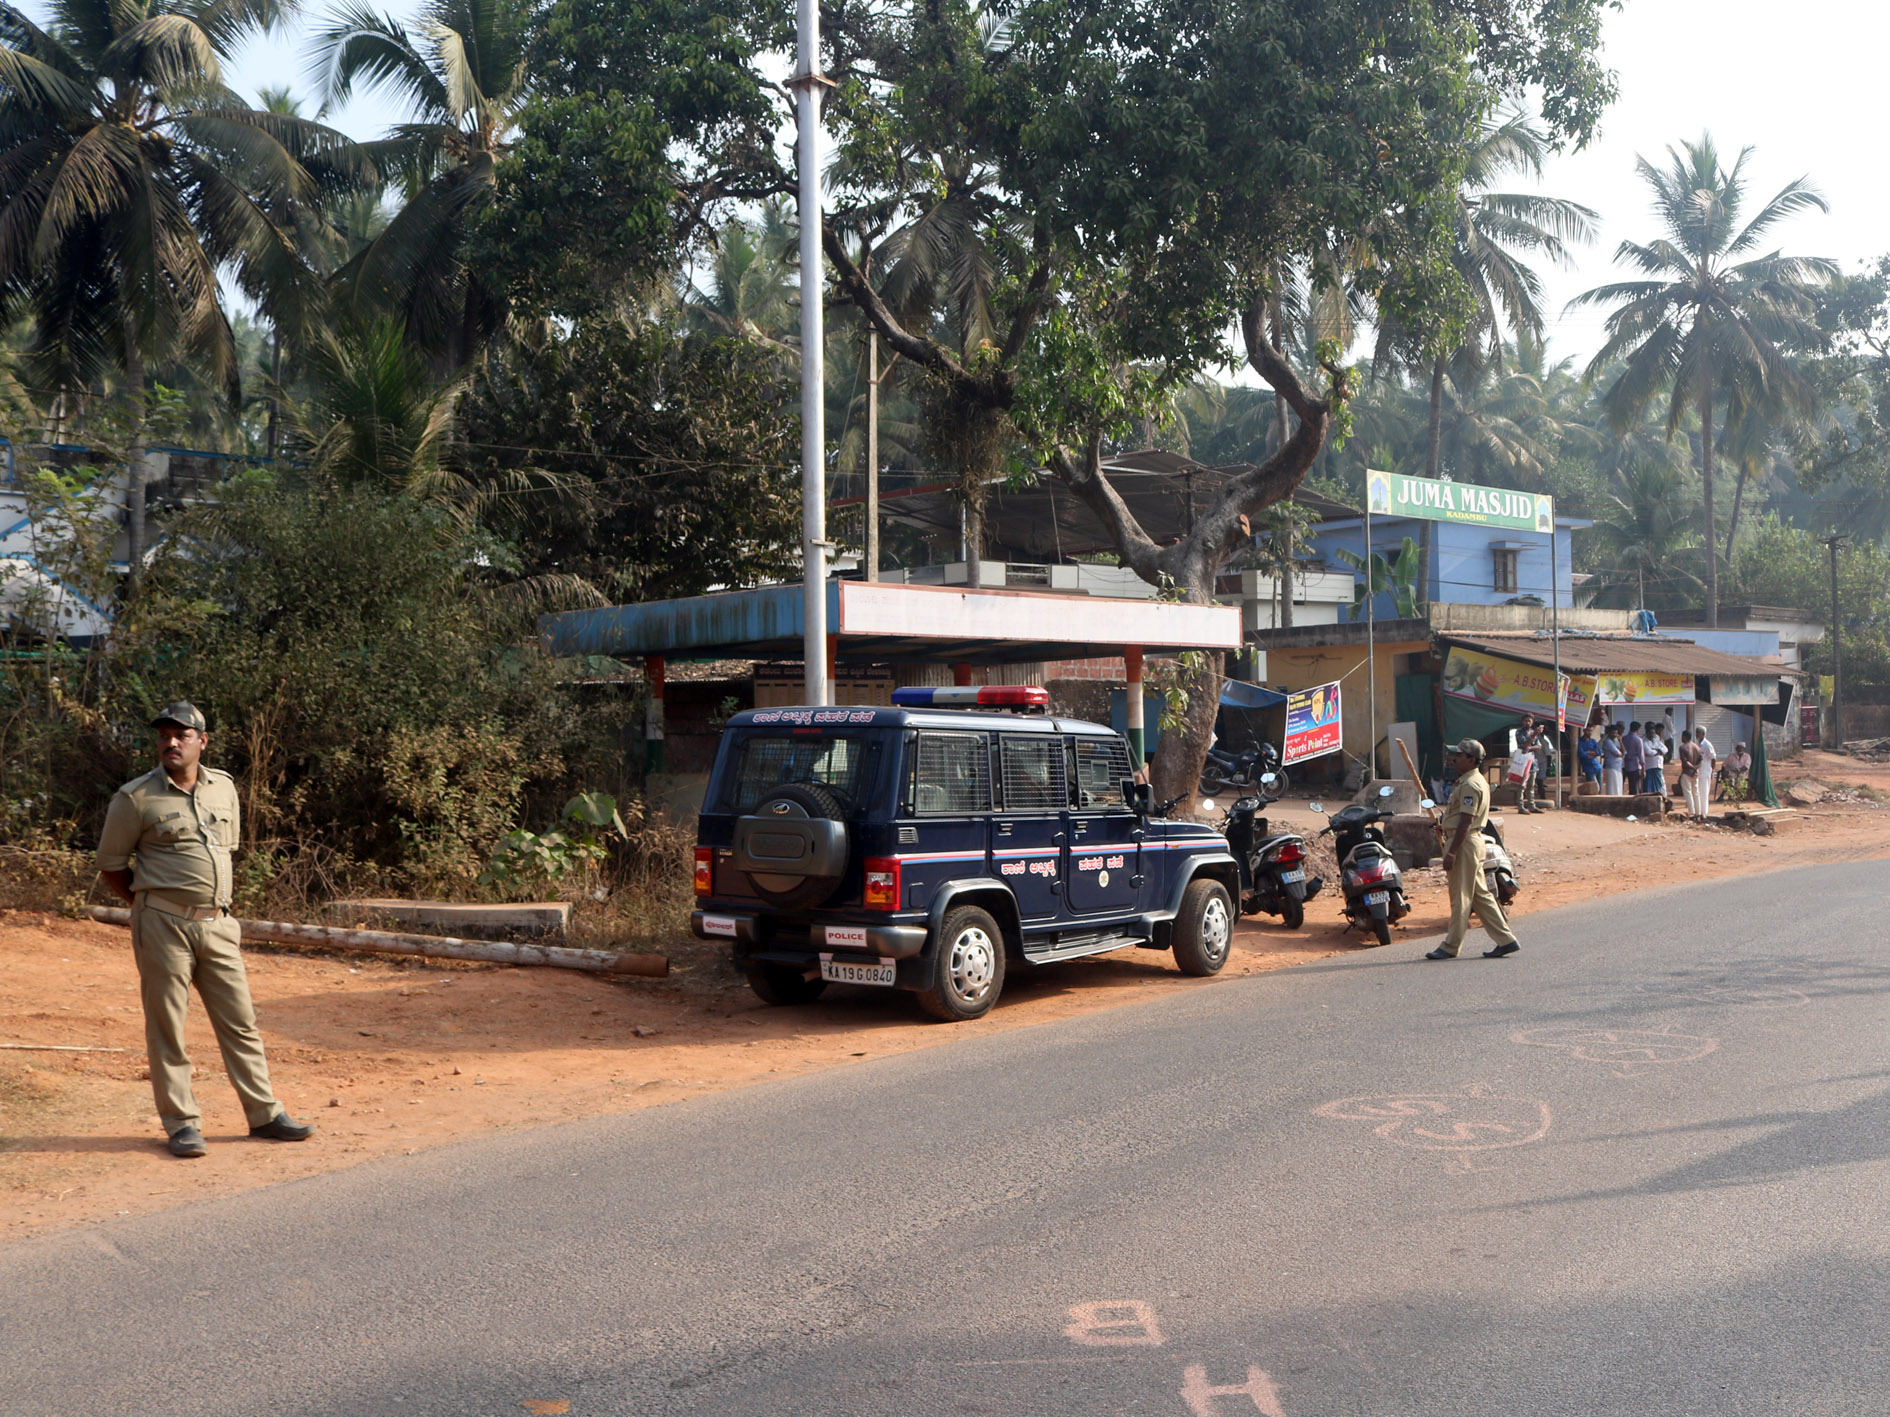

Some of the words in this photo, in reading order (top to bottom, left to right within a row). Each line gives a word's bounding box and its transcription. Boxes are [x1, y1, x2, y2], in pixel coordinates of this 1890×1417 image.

[1397, 479, 1456, 510] JUMA
[1460, 487, 1533, 519] MASJID
[1446, 511, 1487, 521] KADAMBU
[1287, 743, 1307, 758] Sports
[1001, 860, 1026, 875] ರಾಣಿ
[1078, 856, 1104, 871] ಪಹರೆ
[1106, 855, 1124, 869] ಪಡೆ
[828, 932, 864, 941] POLICE
[828, 965, 840, 979] KA
[843, 967, 855, 980] 19
[857, 968, 863, 980] G
[865, 968, 893, 982] 0840
